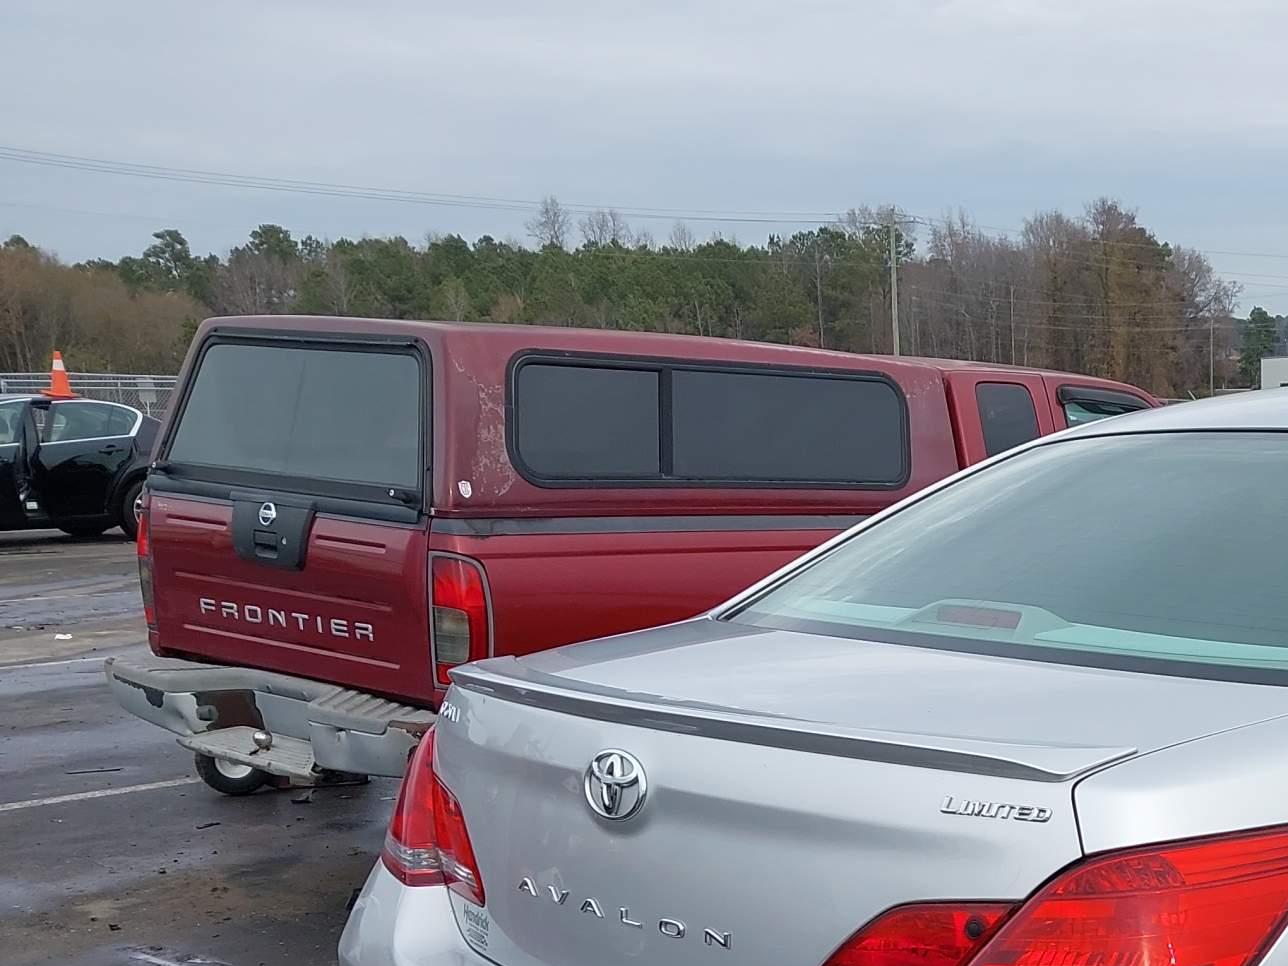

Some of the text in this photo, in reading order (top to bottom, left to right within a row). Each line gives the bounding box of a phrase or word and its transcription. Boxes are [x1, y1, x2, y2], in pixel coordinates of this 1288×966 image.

[199, 597, 375, 642] FRONTIER
[939, 795, 1054, 823] LIMITED
[517, 875, 733, 950] AVALON
